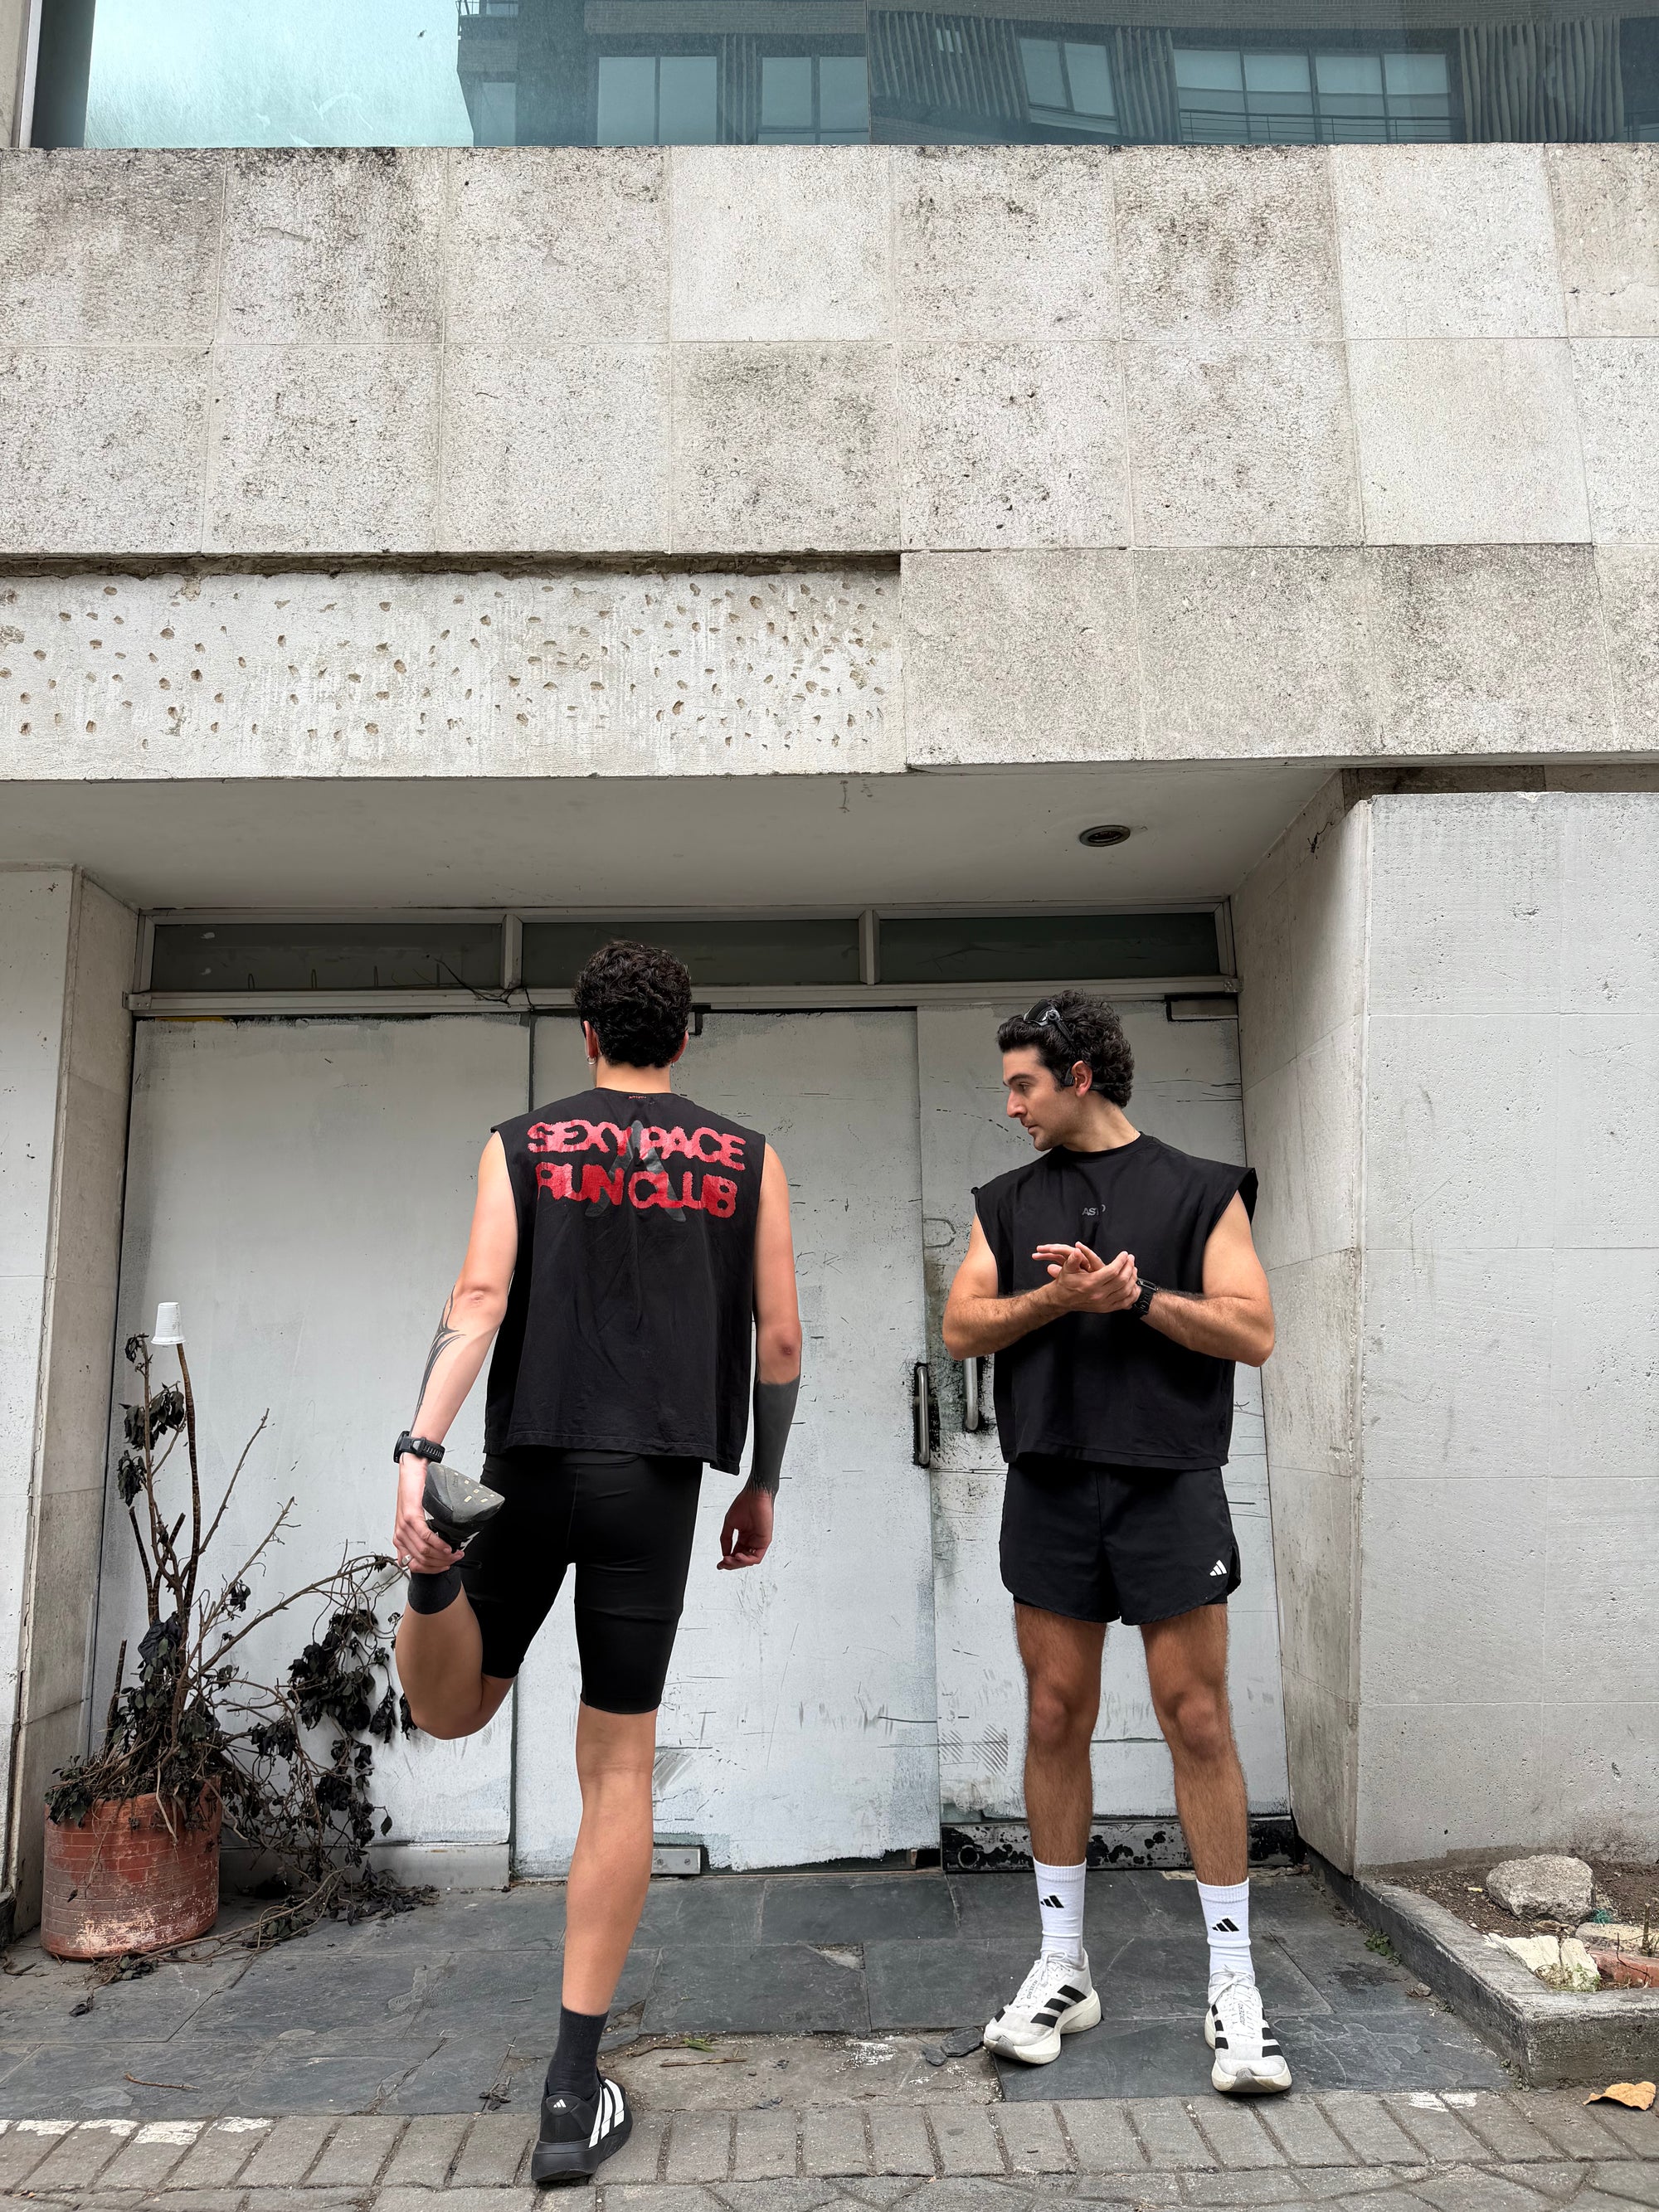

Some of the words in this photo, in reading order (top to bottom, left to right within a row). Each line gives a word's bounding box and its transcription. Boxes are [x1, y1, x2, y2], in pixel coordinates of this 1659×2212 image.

[527, 1120, 633, 1157] SEXY
[640, 1125, 747, 1171] PACE
[535, 1162, 625, 1206] RUN
[628, 1170, 737, 1218] CLUB
